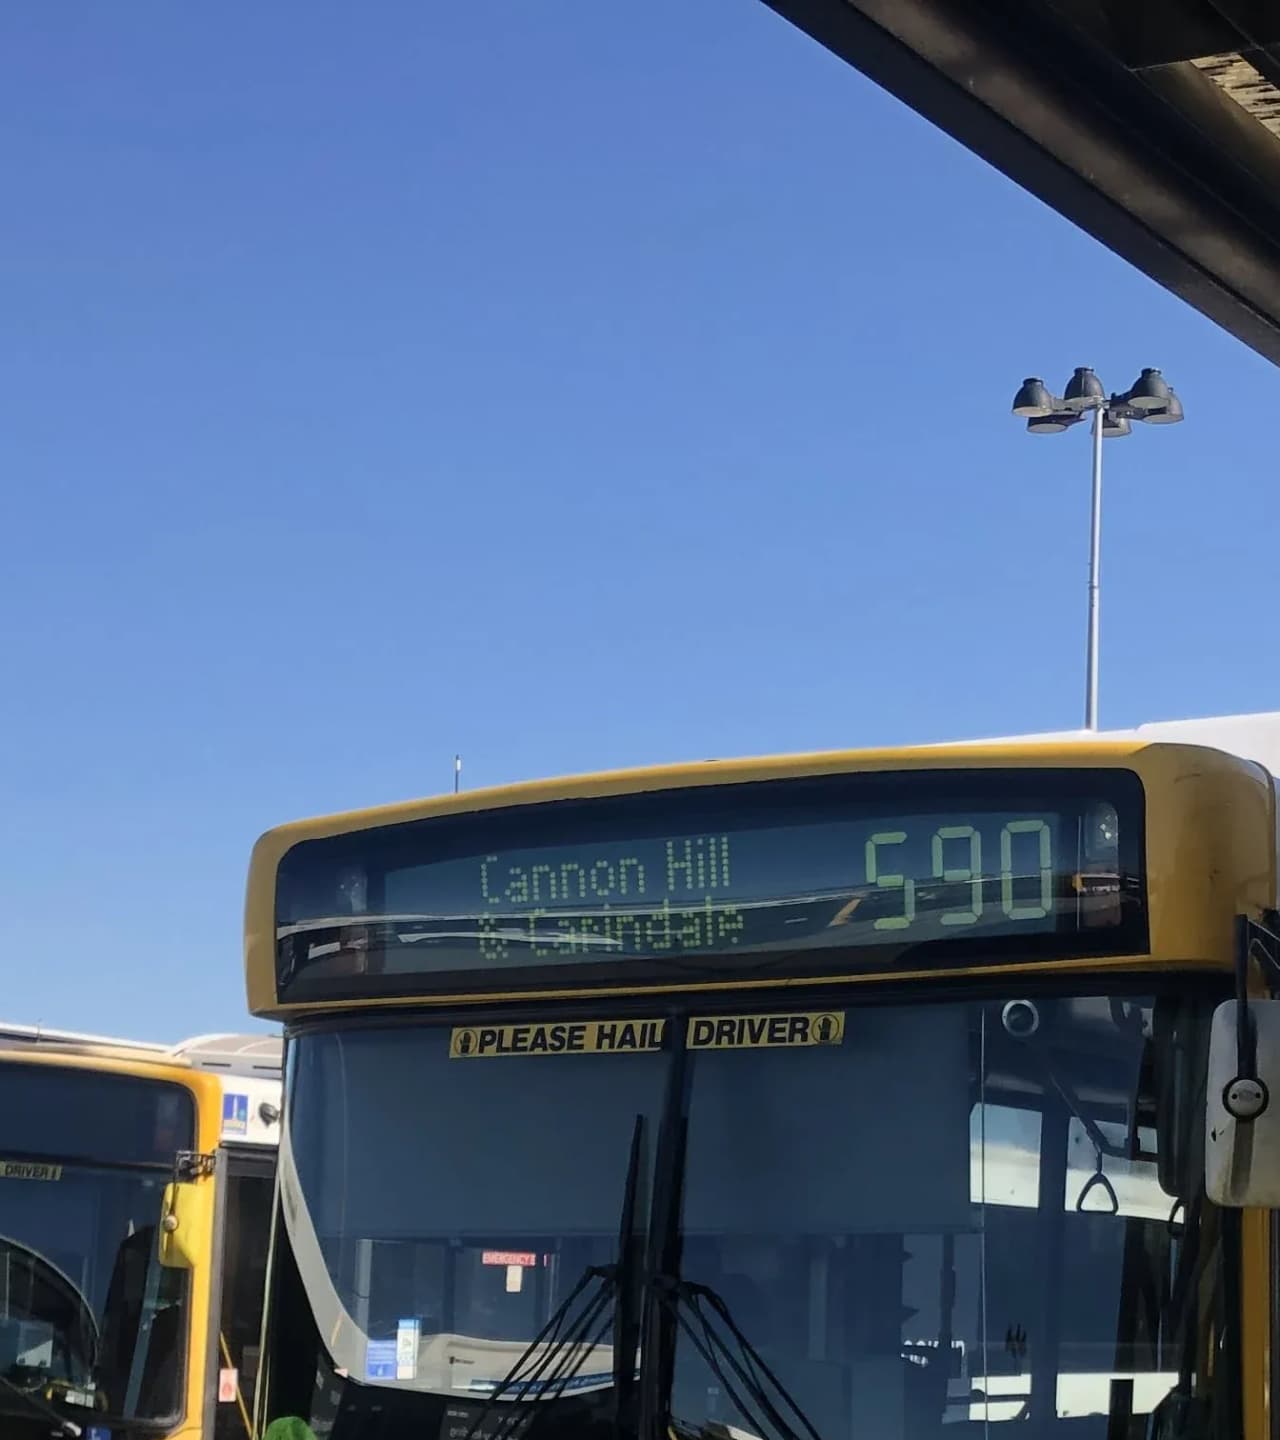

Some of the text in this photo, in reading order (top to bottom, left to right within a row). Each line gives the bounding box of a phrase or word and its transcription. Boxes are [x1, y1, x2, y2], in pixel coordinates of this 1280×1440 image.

[480, 835, 732, 903] Cannon Hill
[865, 819, 1052, 931] 590
[529, 896, 744, 956] Carindale
[478, 1016, 810, 1053] PLEASE HAIL DRIVER
